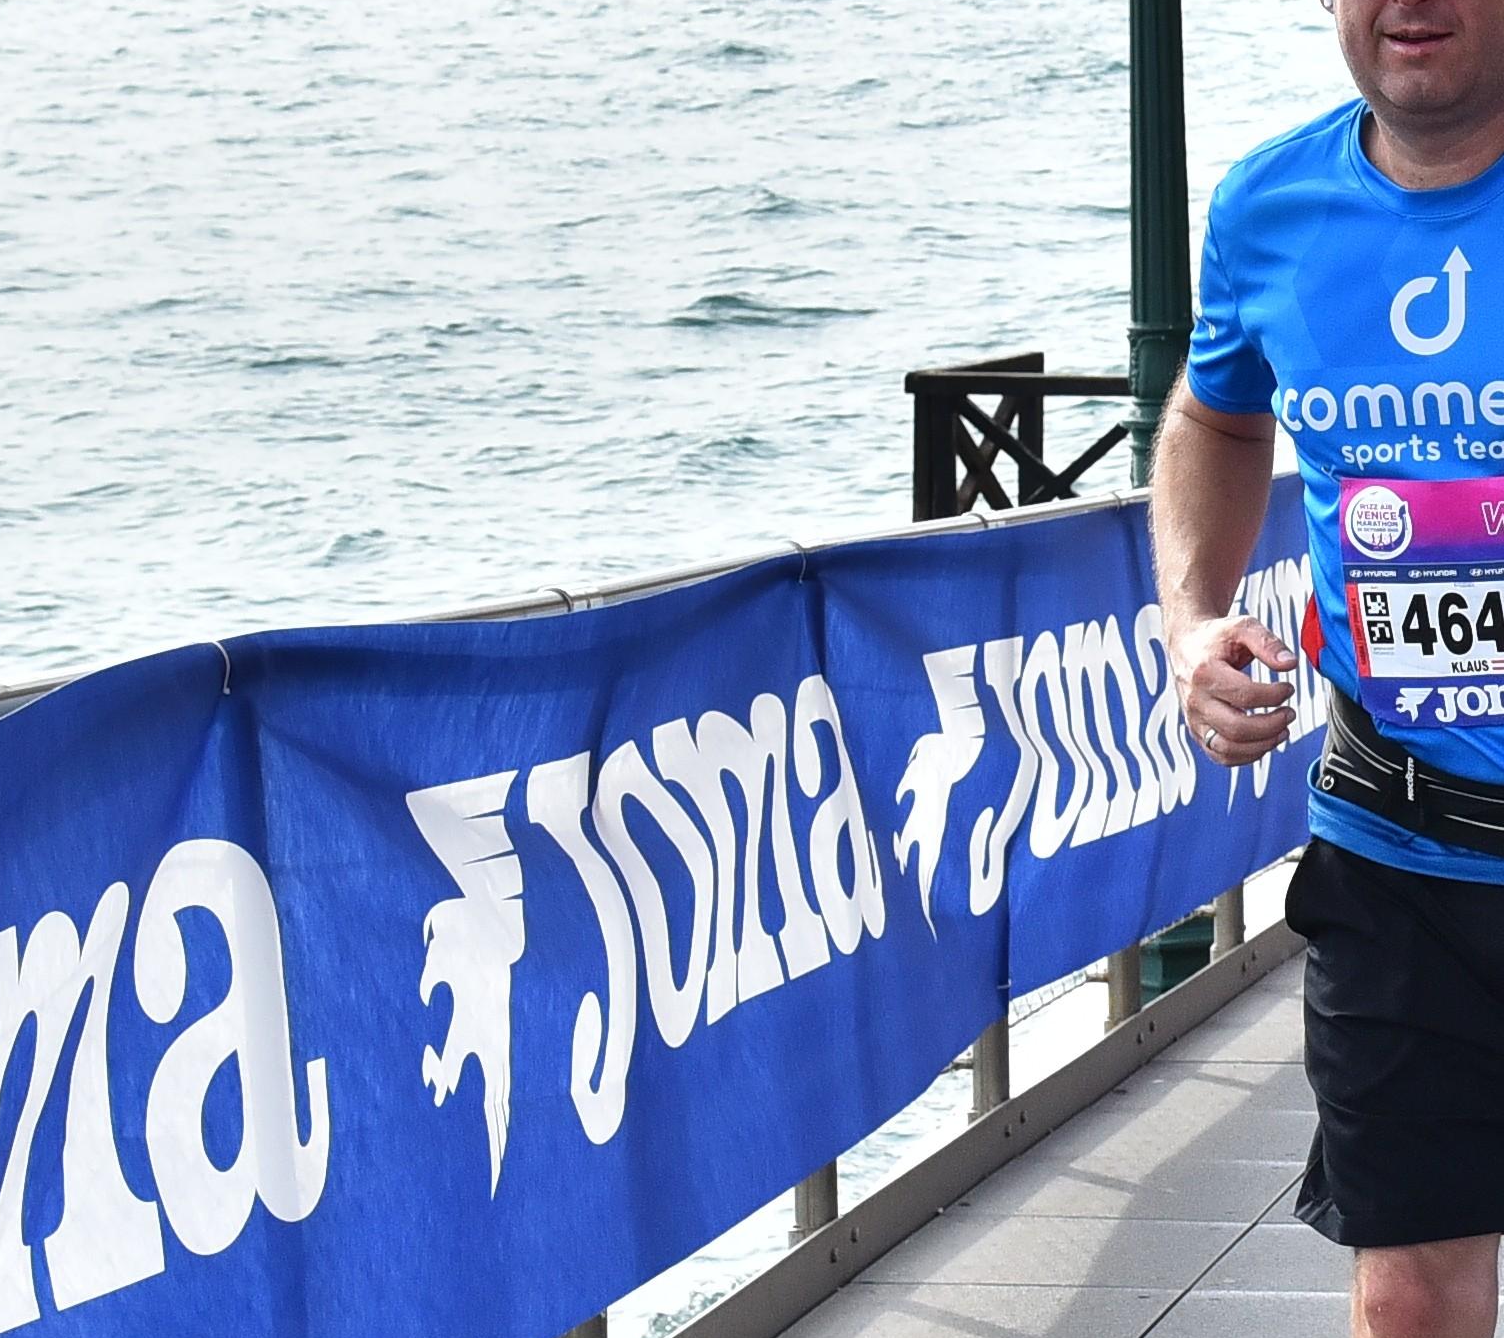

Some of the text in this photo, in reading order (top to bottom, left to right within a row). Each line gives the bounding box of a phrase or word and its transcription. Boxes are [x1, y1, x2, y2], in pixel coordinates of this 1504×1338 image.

[1341, 434, 1441, 470] sports
[1356, 510, 1398, 520] VENICE
[1423, 569, 1458, 578] HYUNDAI
[1451, 659, 1490, 673] KLAUS
[969, 603, 1197, 916] Joma
[527, 674, 886, 1145] Joma
